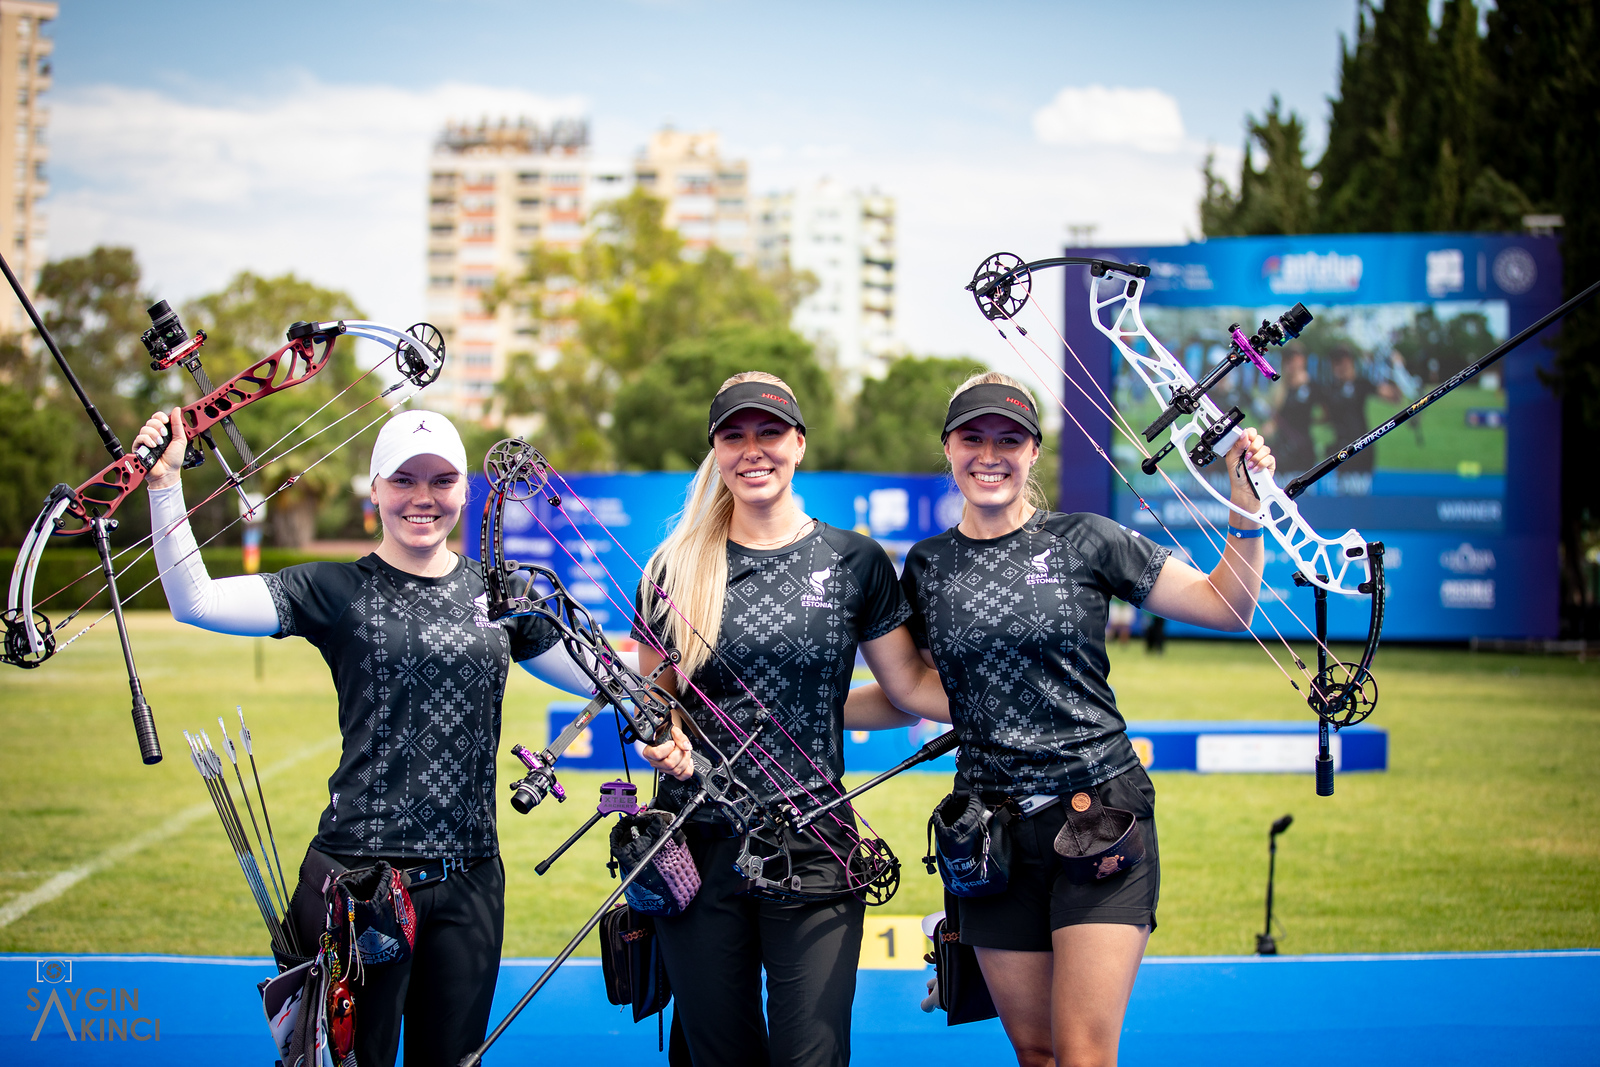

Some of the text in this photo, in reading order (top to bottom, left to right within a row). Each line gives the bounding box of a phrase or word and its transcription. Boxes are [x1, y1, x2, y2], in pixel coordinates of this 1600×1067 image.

[761, 392, 788, 405] HOYT
[1006, 397, 1030, 411] HOYT
[1353, 419, 1396, 452] RAMRODS
[802, 601, 833, 609] ESTONIA
[879, 928, 895, 957] 1
